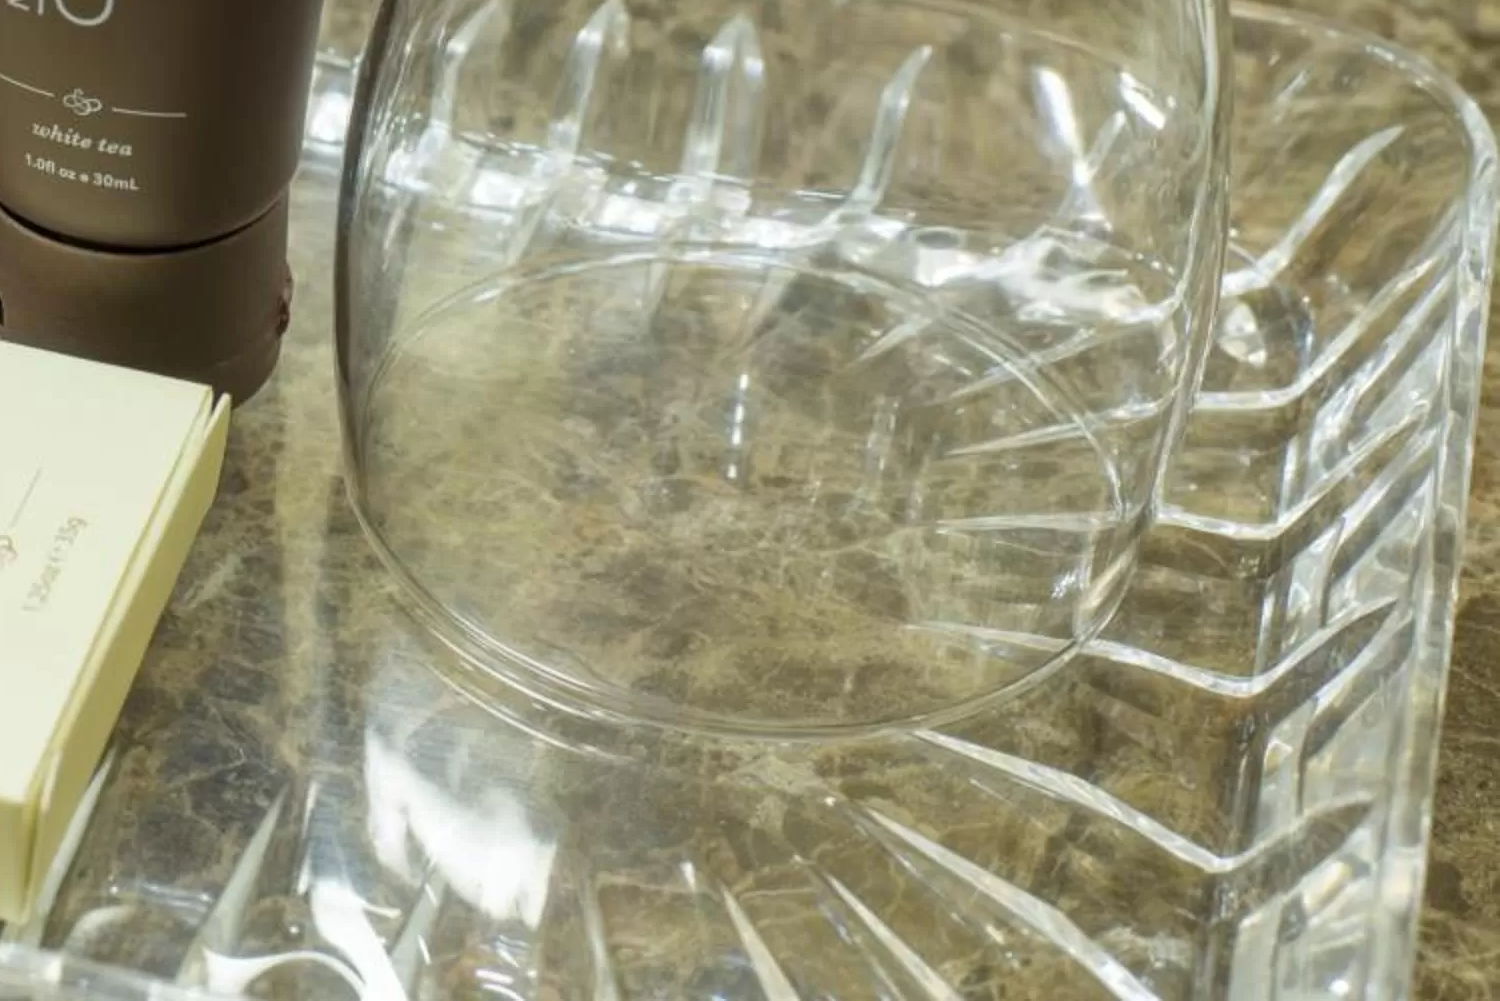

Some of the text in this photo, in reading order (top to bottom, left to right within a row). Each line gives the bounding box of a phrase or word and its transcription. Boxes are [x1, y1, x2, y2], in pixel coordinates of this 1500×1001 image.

[32, 122, 133, 156] white tea
[59, 167, 77, 180] oz
[92, 172, 140, 191] 30mL
